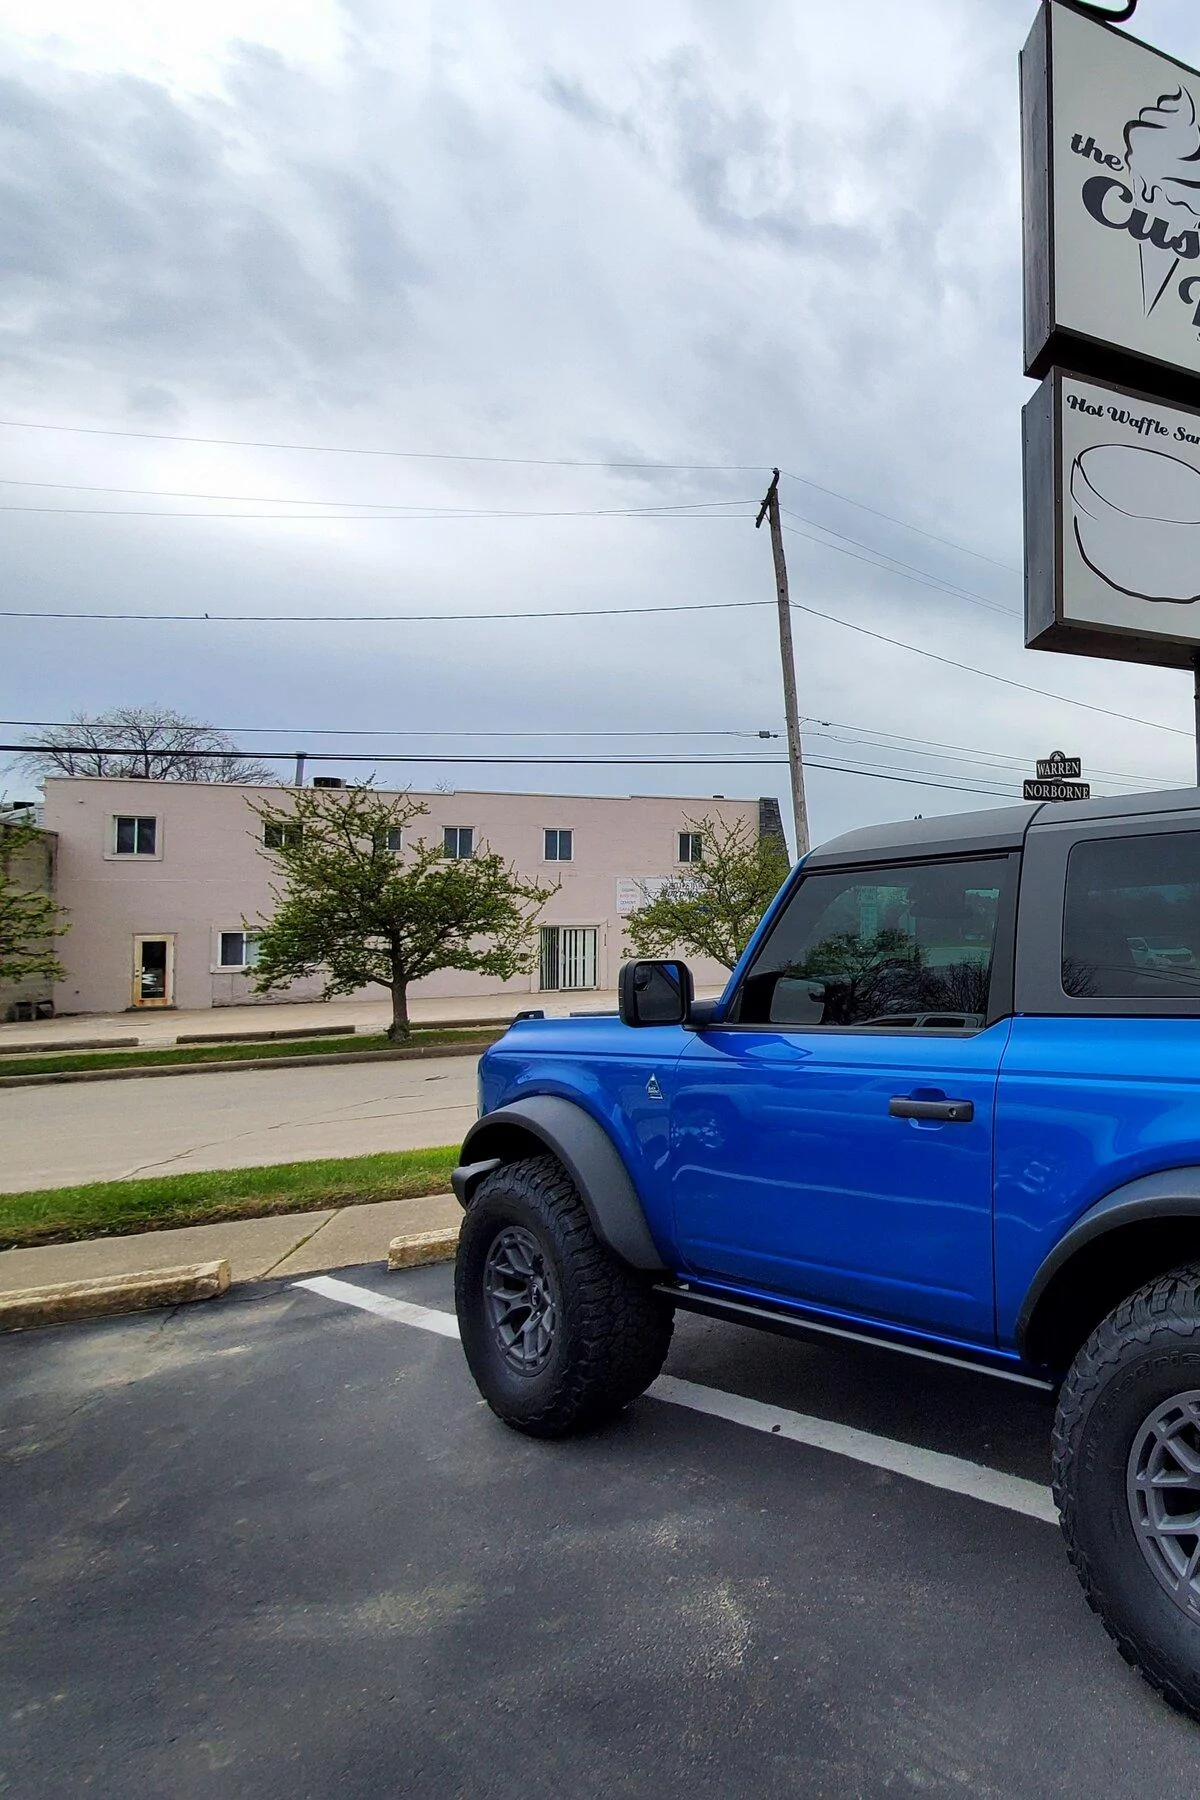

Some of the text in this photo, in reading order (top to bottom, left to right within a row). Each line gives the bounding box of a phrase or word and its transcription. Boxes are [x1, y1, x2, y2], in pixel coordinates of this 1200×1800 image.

[1070, 133, 1125, 172] the
[1066, 394, 1104, 417] Hot
[1106, 406, 1169, 436] Waffle
[1037, 761, 1080, 776] WARREN
[1024, 784, 1089, 799] NORBORNE
